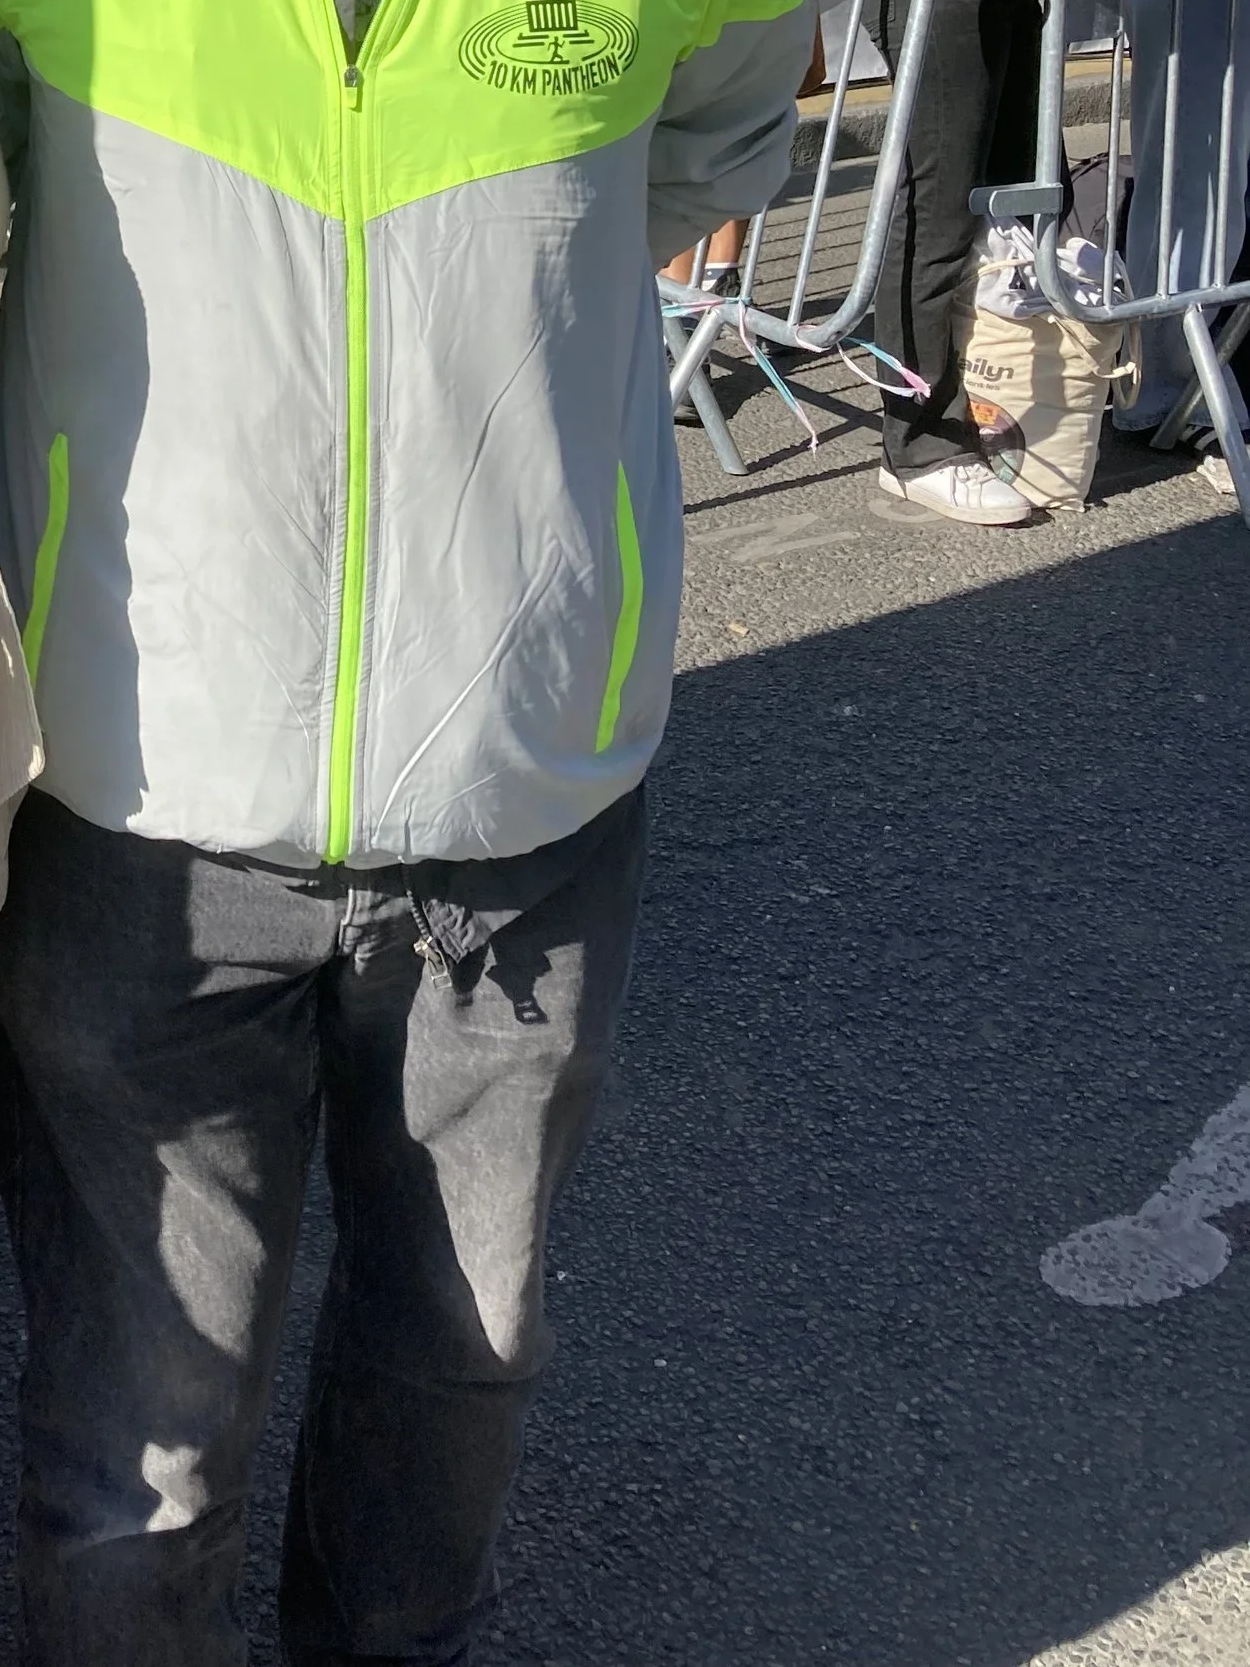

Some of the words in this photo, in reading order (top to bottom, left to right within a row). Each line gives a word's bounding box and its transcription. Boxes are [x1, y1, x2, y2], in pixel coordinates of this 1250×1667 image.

[487, 60, 508, 89] 10
[510, 65, 537, 95] KM
[542, 52, 621, 96] PANTHEON
[957, 357, 1015, 382] ailyn
